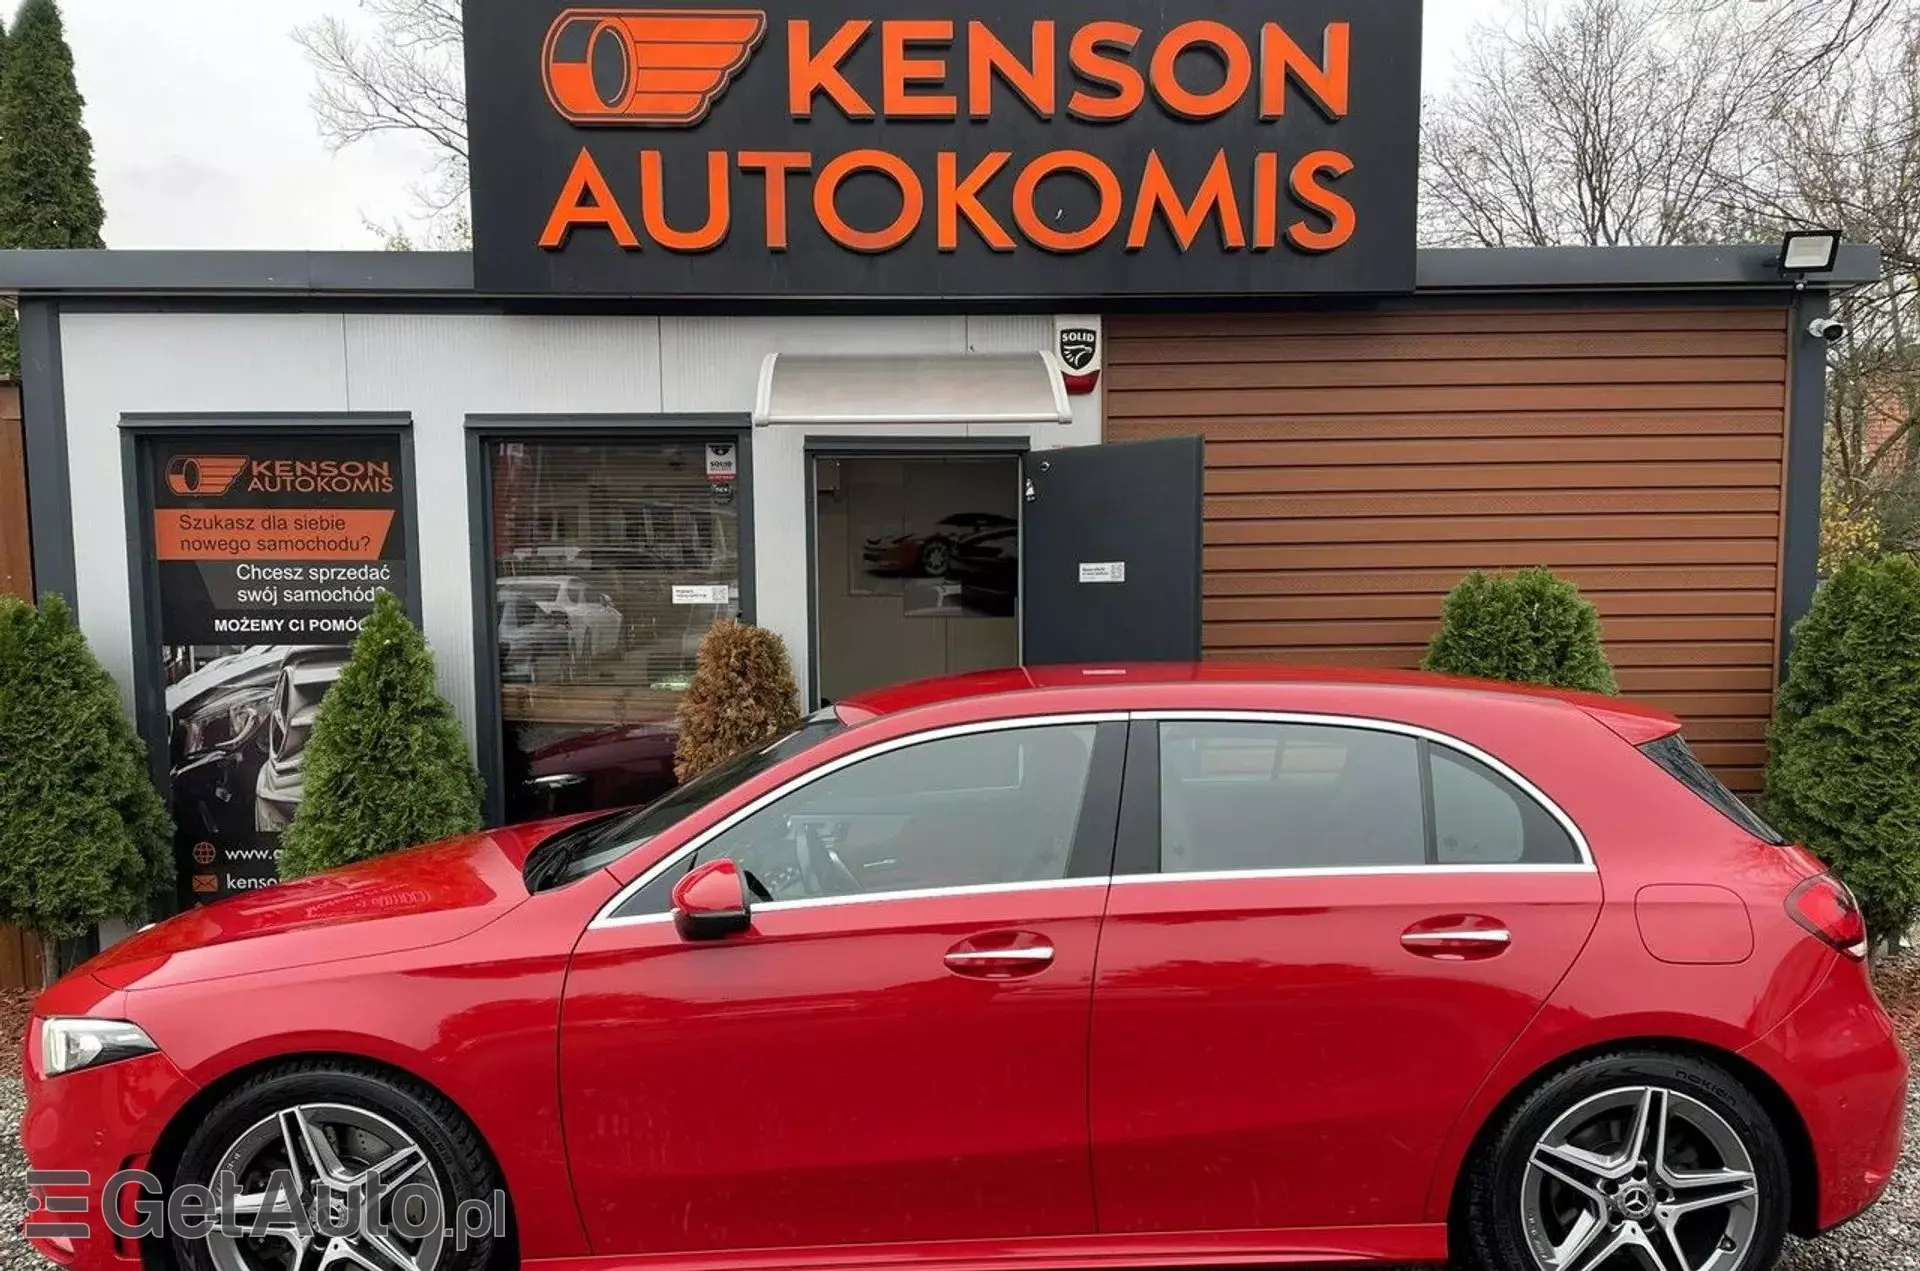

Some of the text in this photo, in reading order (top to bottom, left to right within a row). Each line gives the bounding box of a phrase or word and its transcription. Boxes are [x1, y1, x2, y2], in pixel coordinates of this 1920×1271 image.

[787, 19, 1350, 122] KENSON
[538, 147, 1356, 253] AUTOKOMIS
[1062, 332, 1095, 342] SOLID
[252, 461, 390, 477] KENSON
[248, 477, 394, 493] AUTOKOMIS
[179, 515, 345, 531] Szukasz dla siebie
[180, 536, 371, 554] nowego samochodu?
[236, 564, 391, 584] Chcesz sprzedać
[237, 586, 278, 605] swój
[214, 617, 285, 632] MOŻEMY
[288, 619, 305, 632] CI
